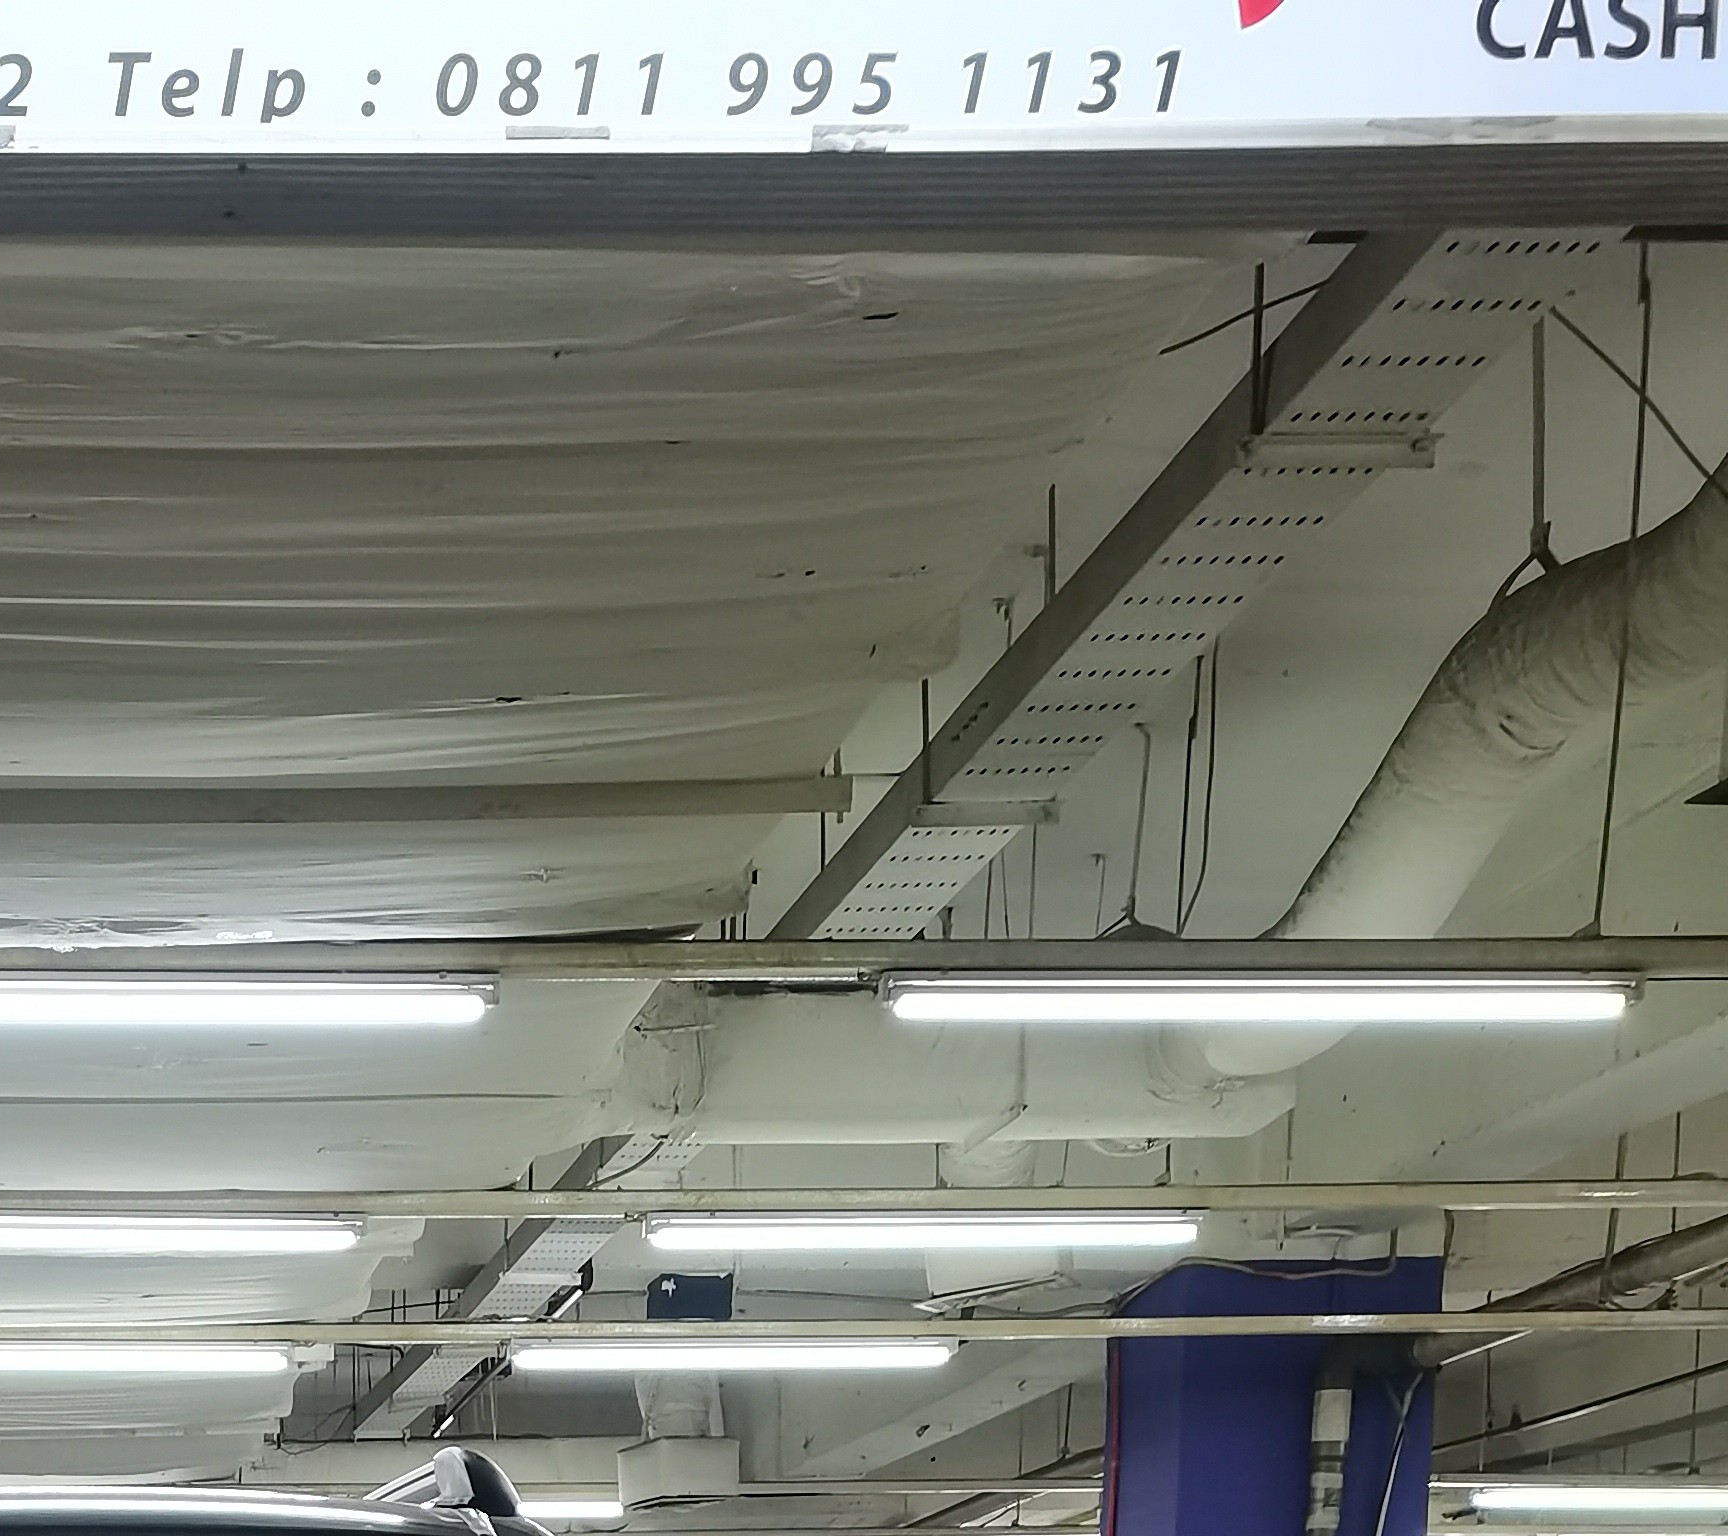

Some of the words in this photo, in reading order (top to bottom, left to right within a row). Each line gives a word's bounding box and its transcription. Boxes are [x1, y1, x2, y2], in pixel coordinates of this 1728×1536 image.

[1476, 0, 1718, 60] CASH
[108, 48, 307, 124] Telp
[435, 52, 665, 117] 0811
[726, 50, 899, 116] 995
[961, 49, 1183, 114] 1131
